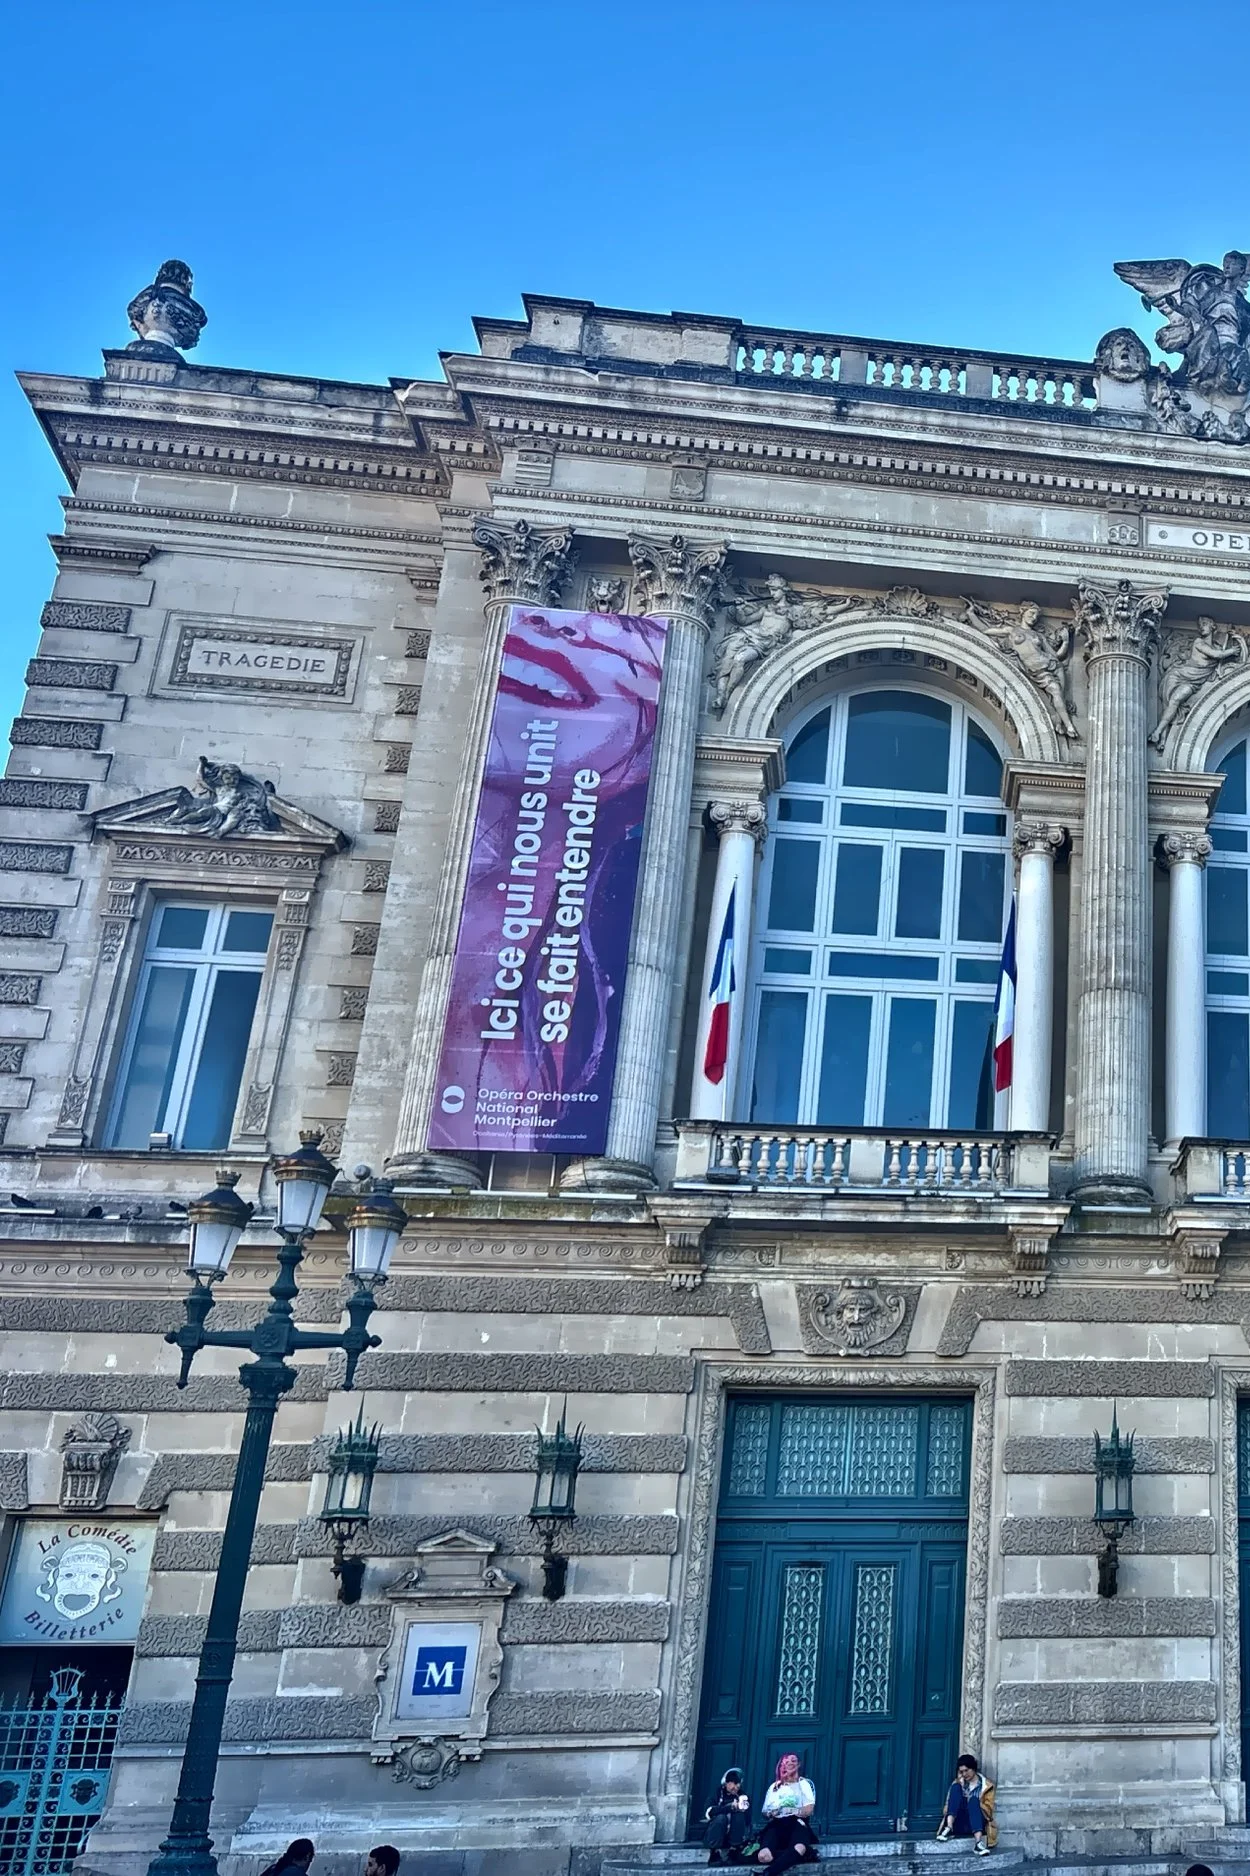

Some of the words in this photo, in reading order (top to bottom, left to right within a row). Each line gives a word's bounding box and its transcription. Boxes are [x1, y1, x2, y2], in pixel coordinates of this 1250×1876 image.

[202, 649, 326, 673] TRAGEDIE
[520, 719, 559, 786] unit
[510, 792, 549, 877] nous
[555, 768, 601, 931] entendre
[497, 882, 543, 940] qui
[495, 945, 527, 991] ce
[537, 934, 580, 994] fait
[481, 997, 519, 1041] Ici
[540, 999, 572, 1043] se
[476, 1101, 539, 1114] National
[478, 1088, 524, 1101] Opéra
[526, 1090, 599, 1103] Orchestre
[474, 1114, 558, 1129] Montpellier
[37, 1533, 61, 1554] La
[68, 1524, 137, 1556] Comédie
[24, 1607, 125, 1641] Billetterie
[422, 1661, 455, 1688] M
